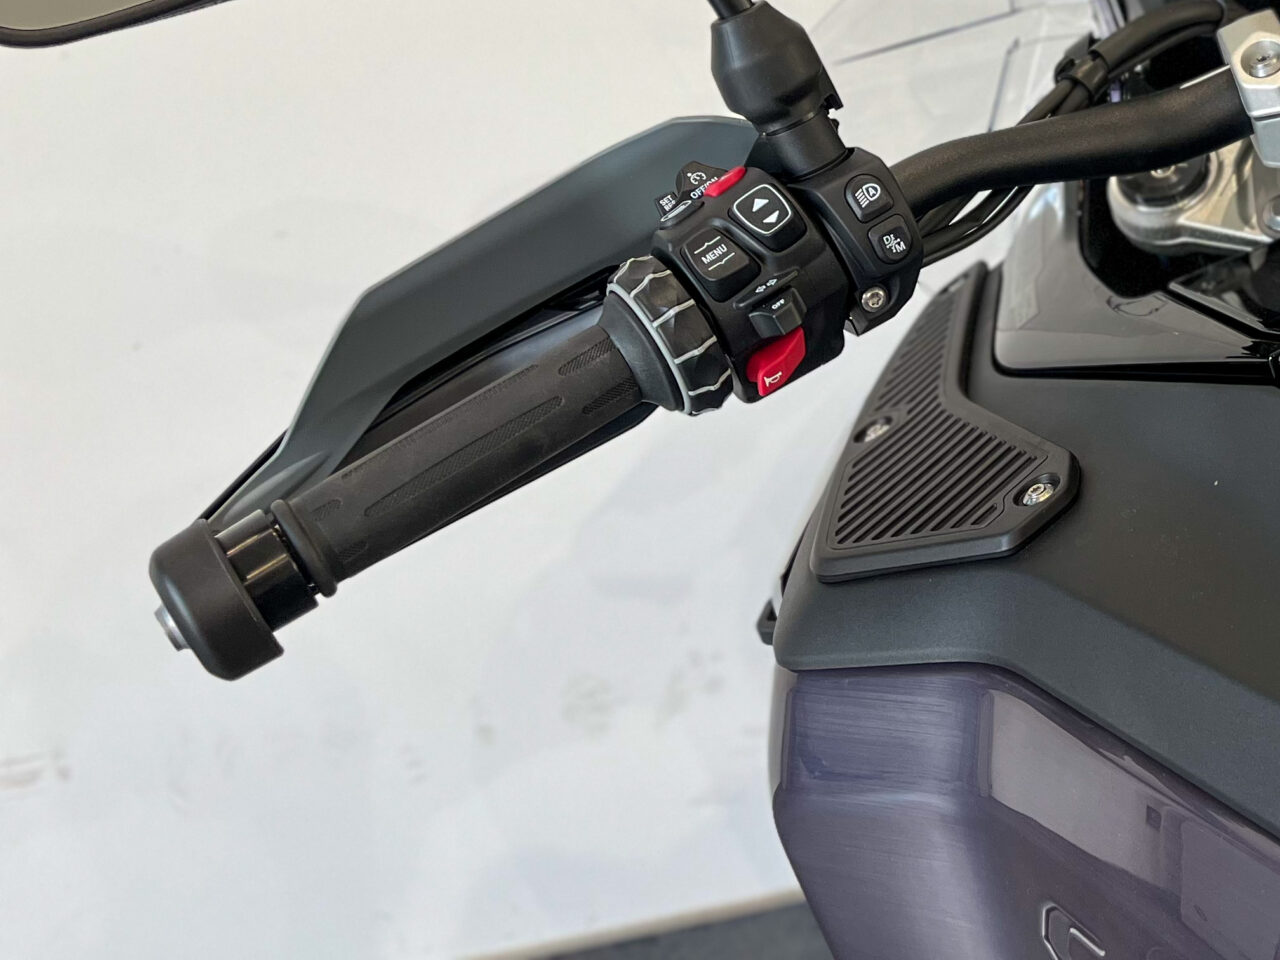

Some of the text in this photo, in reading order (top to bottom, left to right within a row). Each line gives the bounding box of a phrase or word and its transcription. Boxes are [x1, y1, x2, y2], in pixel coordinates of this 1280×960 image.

[868, 187, 876, 196] A
[659, 194, 673, 206] SET
[701, 243, 727, 264] MENU
[771, 298, 785, 310] OFF
